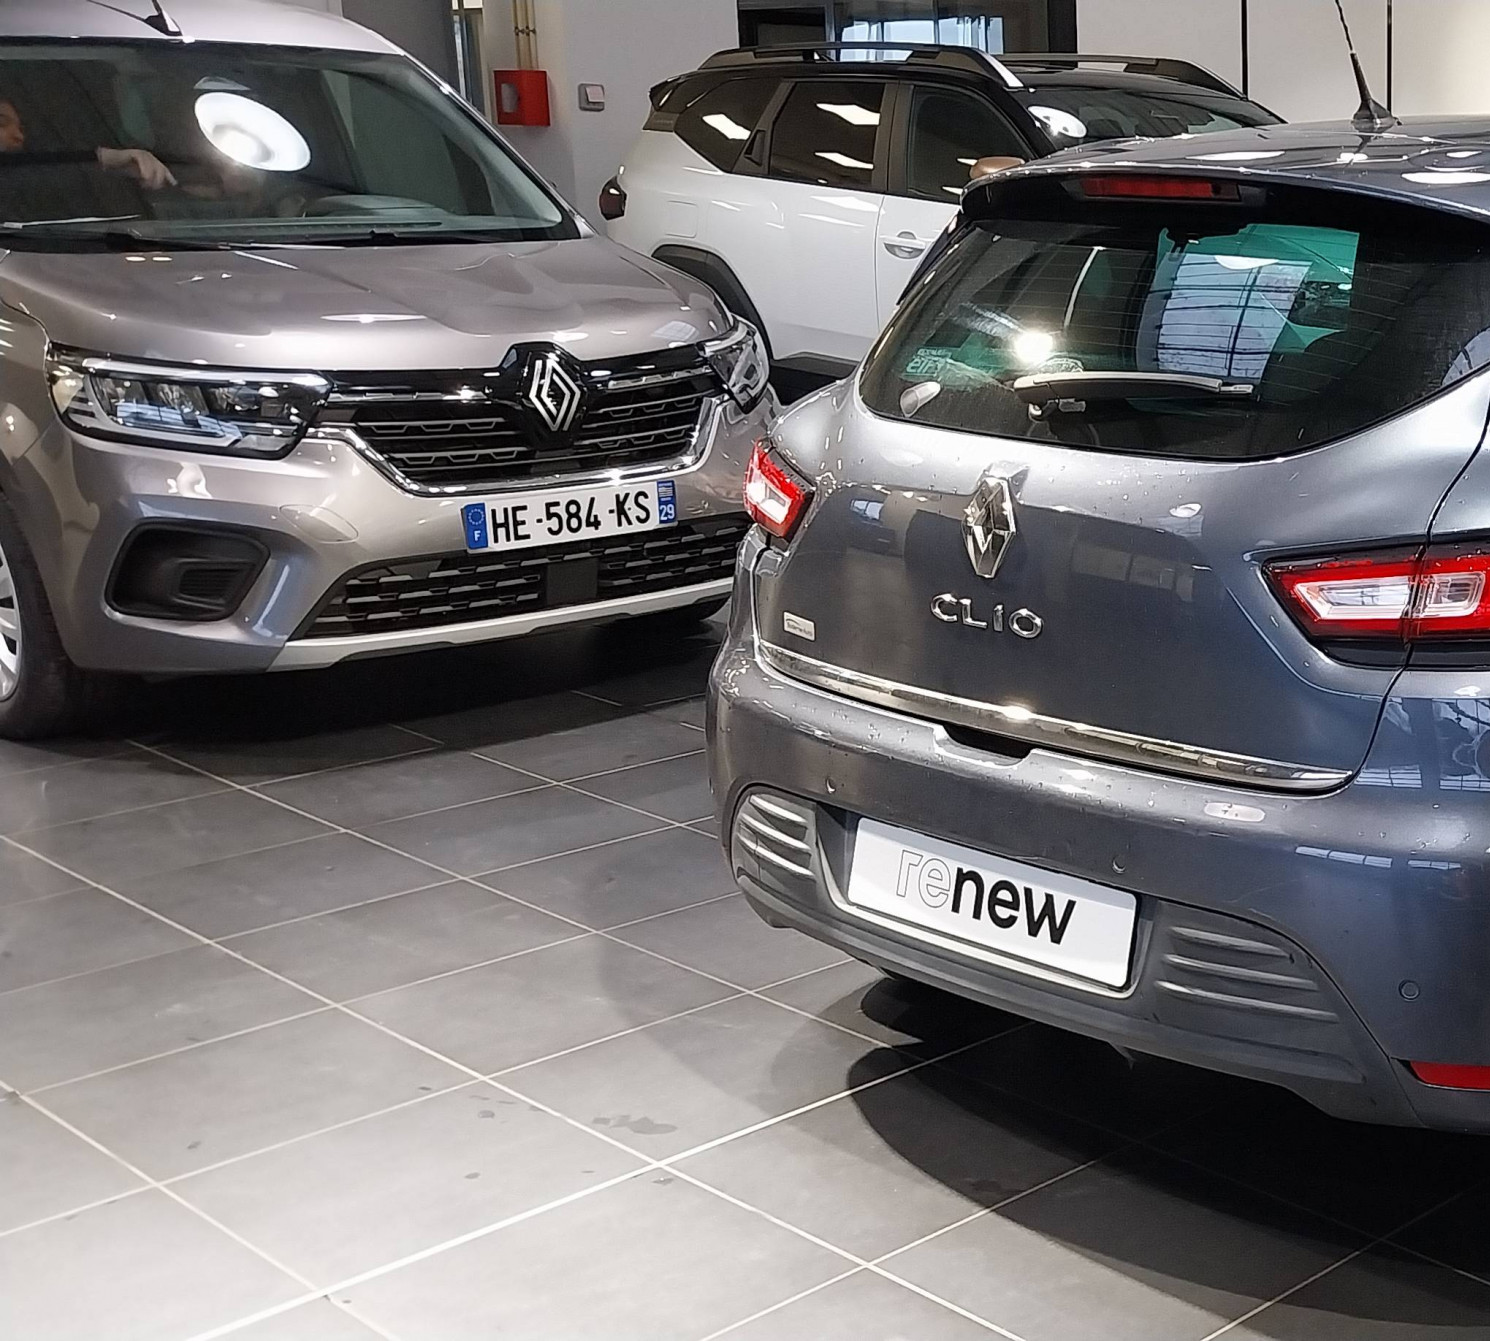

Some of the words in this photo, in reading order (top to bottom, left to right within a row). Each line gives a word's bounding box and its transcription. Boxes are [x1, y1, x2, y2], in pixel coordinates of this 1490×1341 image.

[659, 503, 675, 521] 29
[473, 530, 481, 542] F
[930, 592, 1045, 640] CLIO
[895, 848, 1077, 946] renew
